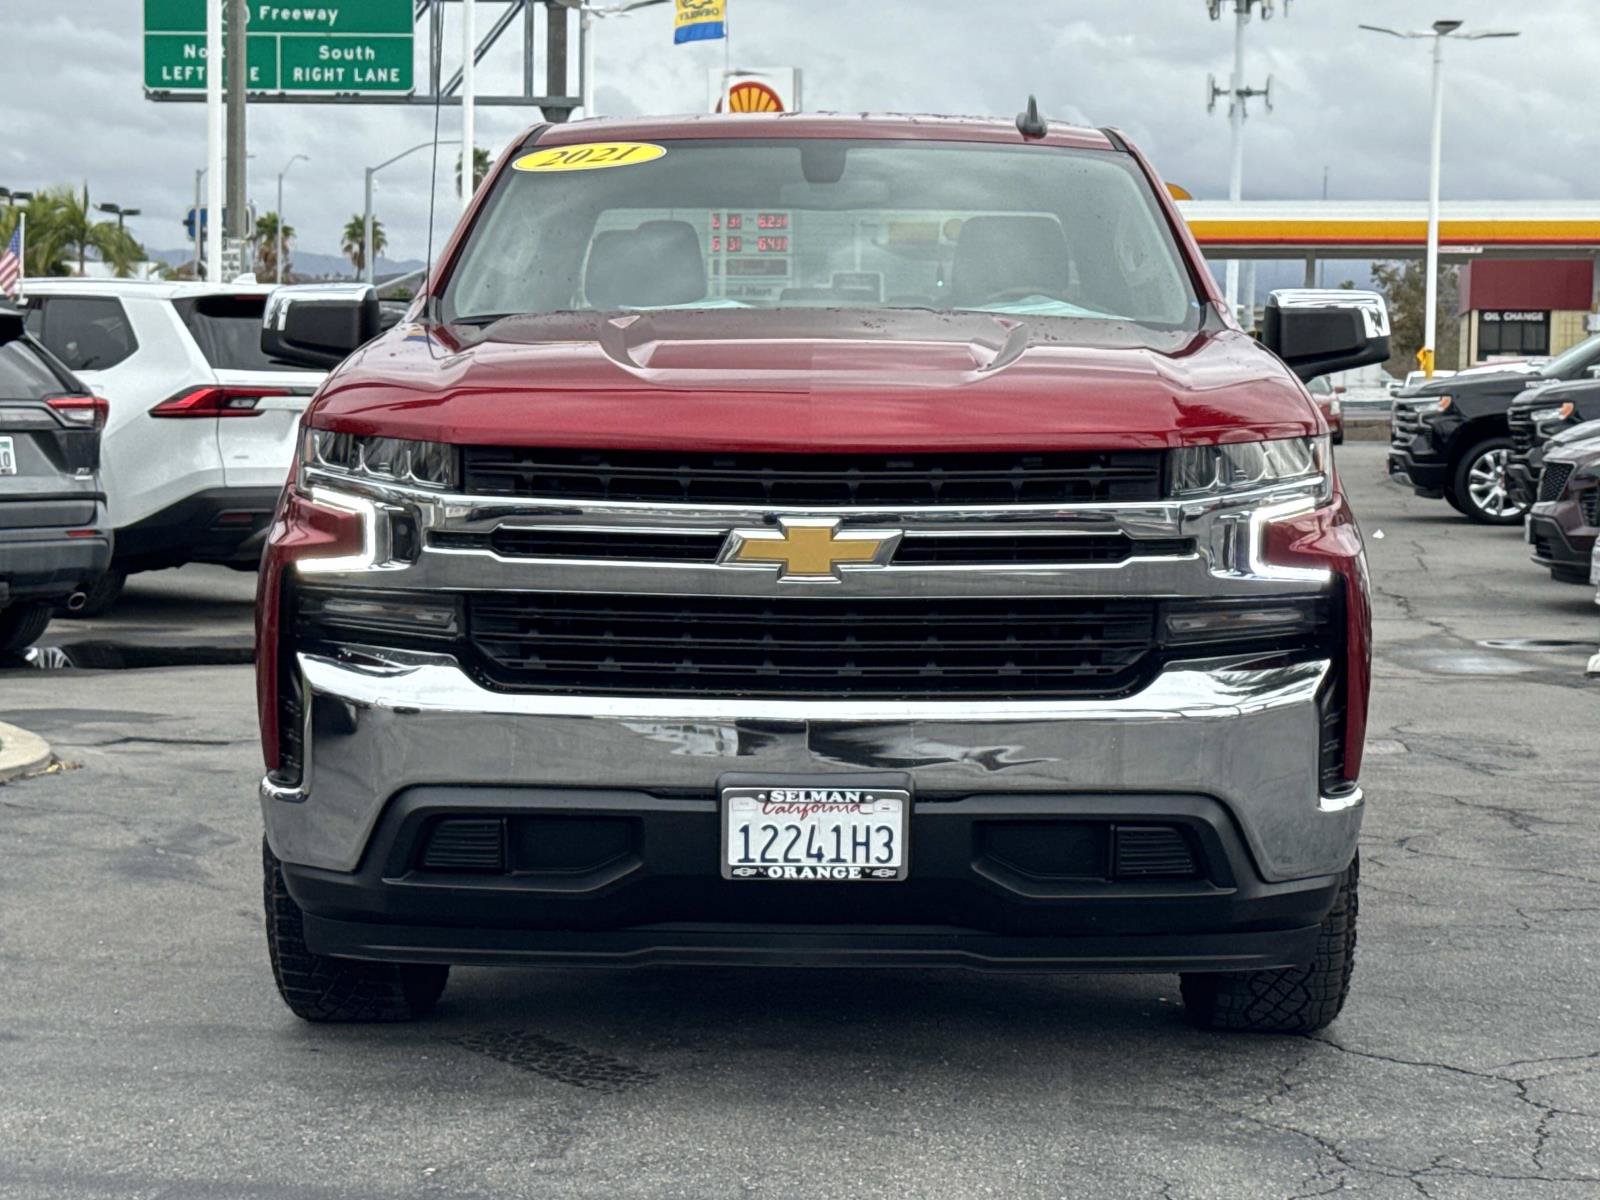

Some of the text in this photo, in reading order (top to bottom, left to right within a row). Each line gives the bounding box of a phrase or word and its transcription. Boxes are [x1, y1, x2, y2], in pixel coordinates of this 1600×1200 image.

[259, 6, 339, 26] Freeway
[318, 45, 376, 60] South
[162, 66, 205, 81] LEFT
[293, 67, 400, 82] RIGHT LANE
[536, 146, 641, 167] 2021
[1483, 312, 1544, 321] OIL CHANGE
[770, 791, 861, 802] SELMAN
[762, 801, 873, 820] California
[737, 823, 894, 864] 12241H3
[768, 866, 862, 879] ORANGE
